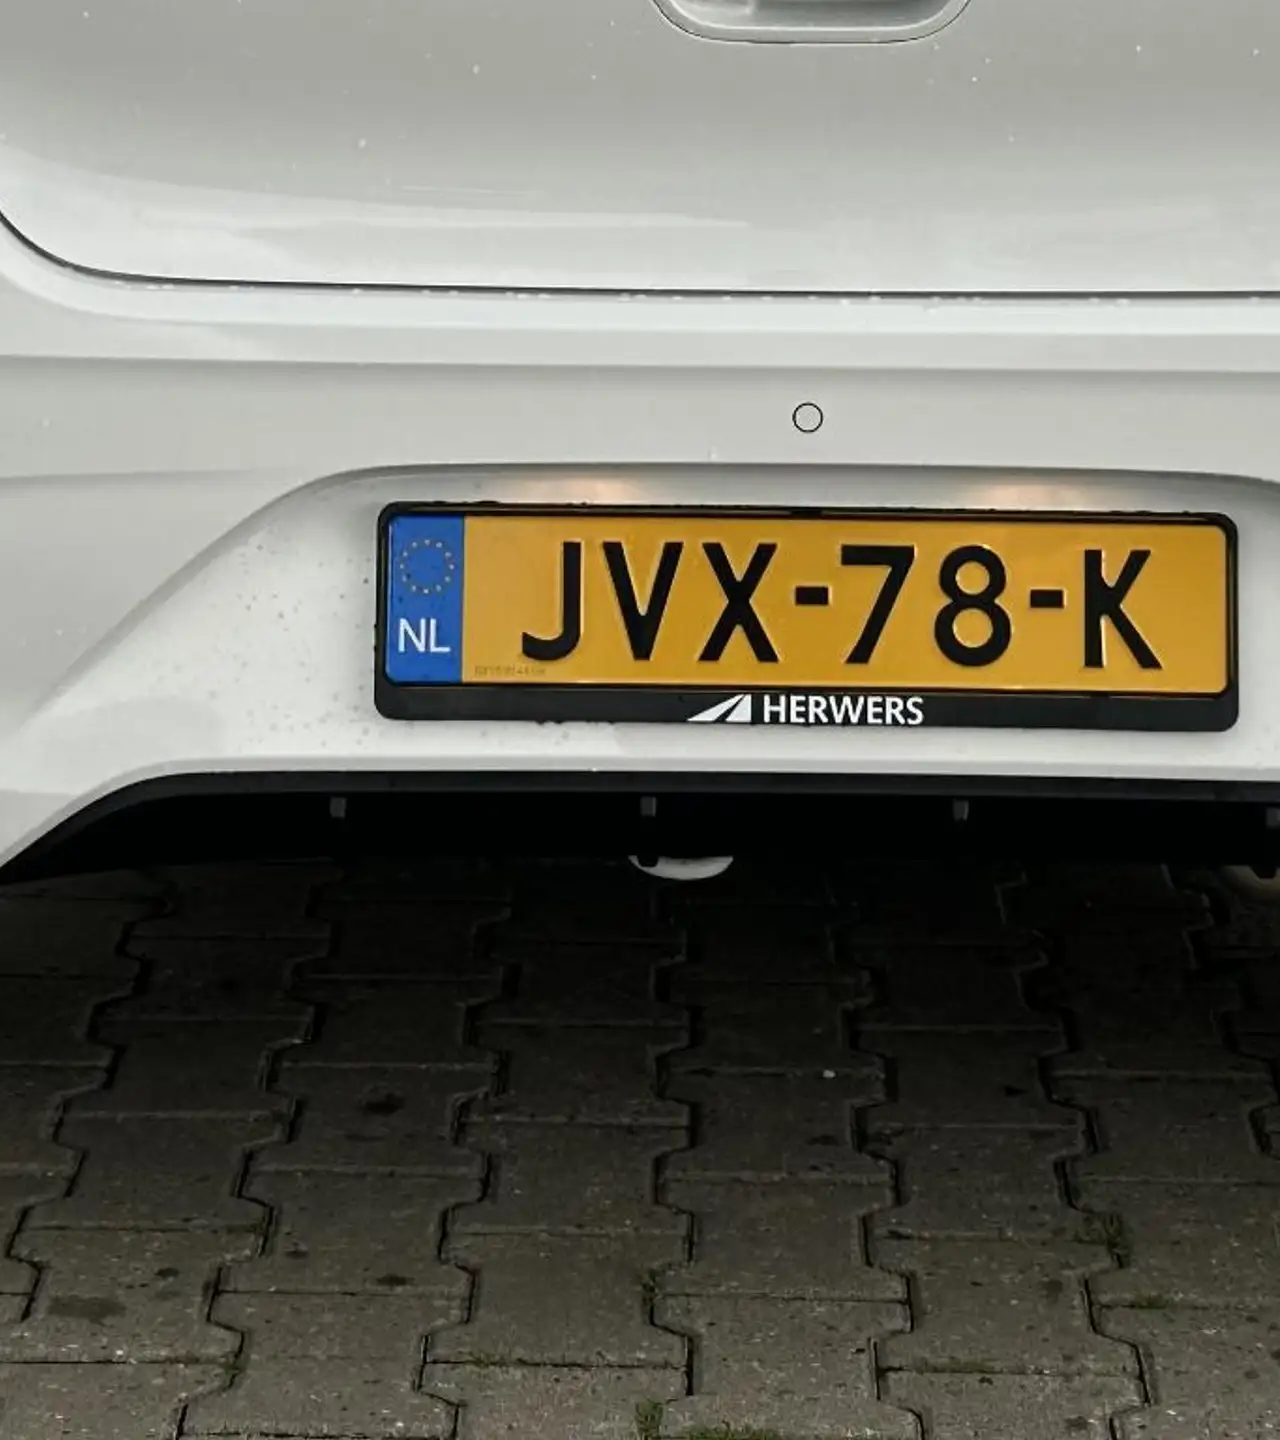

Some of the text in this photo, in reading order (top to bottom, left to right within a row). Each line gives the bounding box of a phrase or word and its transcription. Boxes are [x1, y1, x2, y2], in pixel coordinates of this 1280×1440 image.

[521, 540, 1163, 670] JVX-78-K
[398, 617, 452, 654] NL
[762, 693, 925, 726] HERWERS
